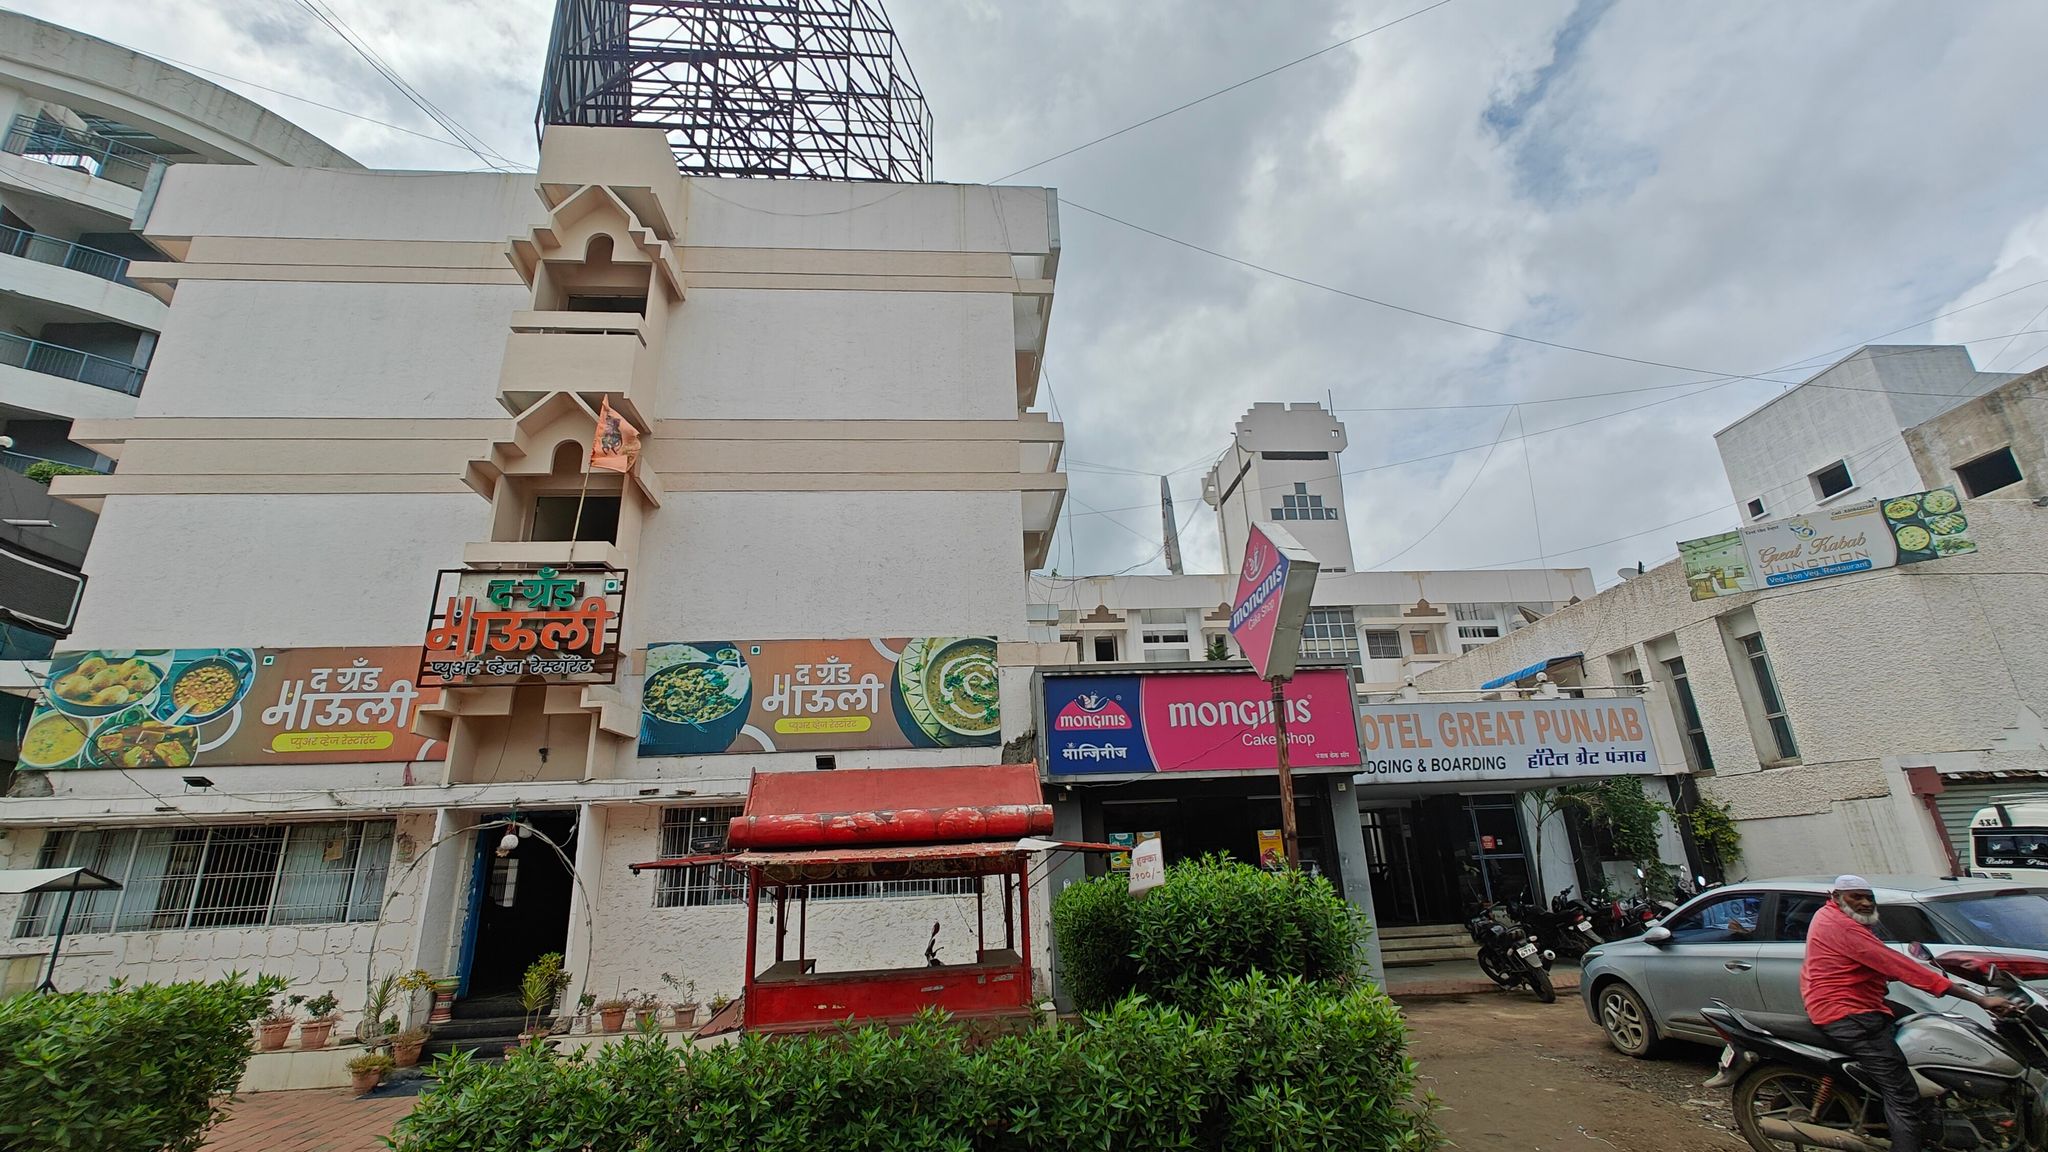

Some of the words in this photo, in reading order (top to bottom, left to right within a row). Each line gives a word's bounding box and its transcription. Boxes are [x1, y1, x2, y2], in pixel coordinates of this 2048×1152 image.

[1759, 543, 1802, 568] Great
[1808, 532, 1867, 555] Kabab
[1763, 549, 1868, 576] JUNCTION
[1822, 561, 1869, 575] Restaurant
[490, 579, 517, 609] द
[431, 659, 482, 681] प्युअर
[487, 656, 524, 676] व्हेज
[529, 655, 595, 676] रेस्टॉरंट
[795, 664, 812, 684] द
[310, 668, 333, 692] द
[1438, 711, 1526, 748] GREAT
[1533, 707, 1643, 745] PUNJAB
[290, 736, 318, 749] प्युअर
[319, 735, 339, 747] व्हेज
[1242, 732, 1277, 747] Cake
[1286, 731, 1316, 747] hop
[1417, 758, 1427, 772] &
[1431, 756, 1507, 772] BOARDING
[1527, 748, 1570, 768] हॉटेल
[1575, 747, 1601, 766] ग्रेट
[1605, 747, 1648, 763] पंजाब
